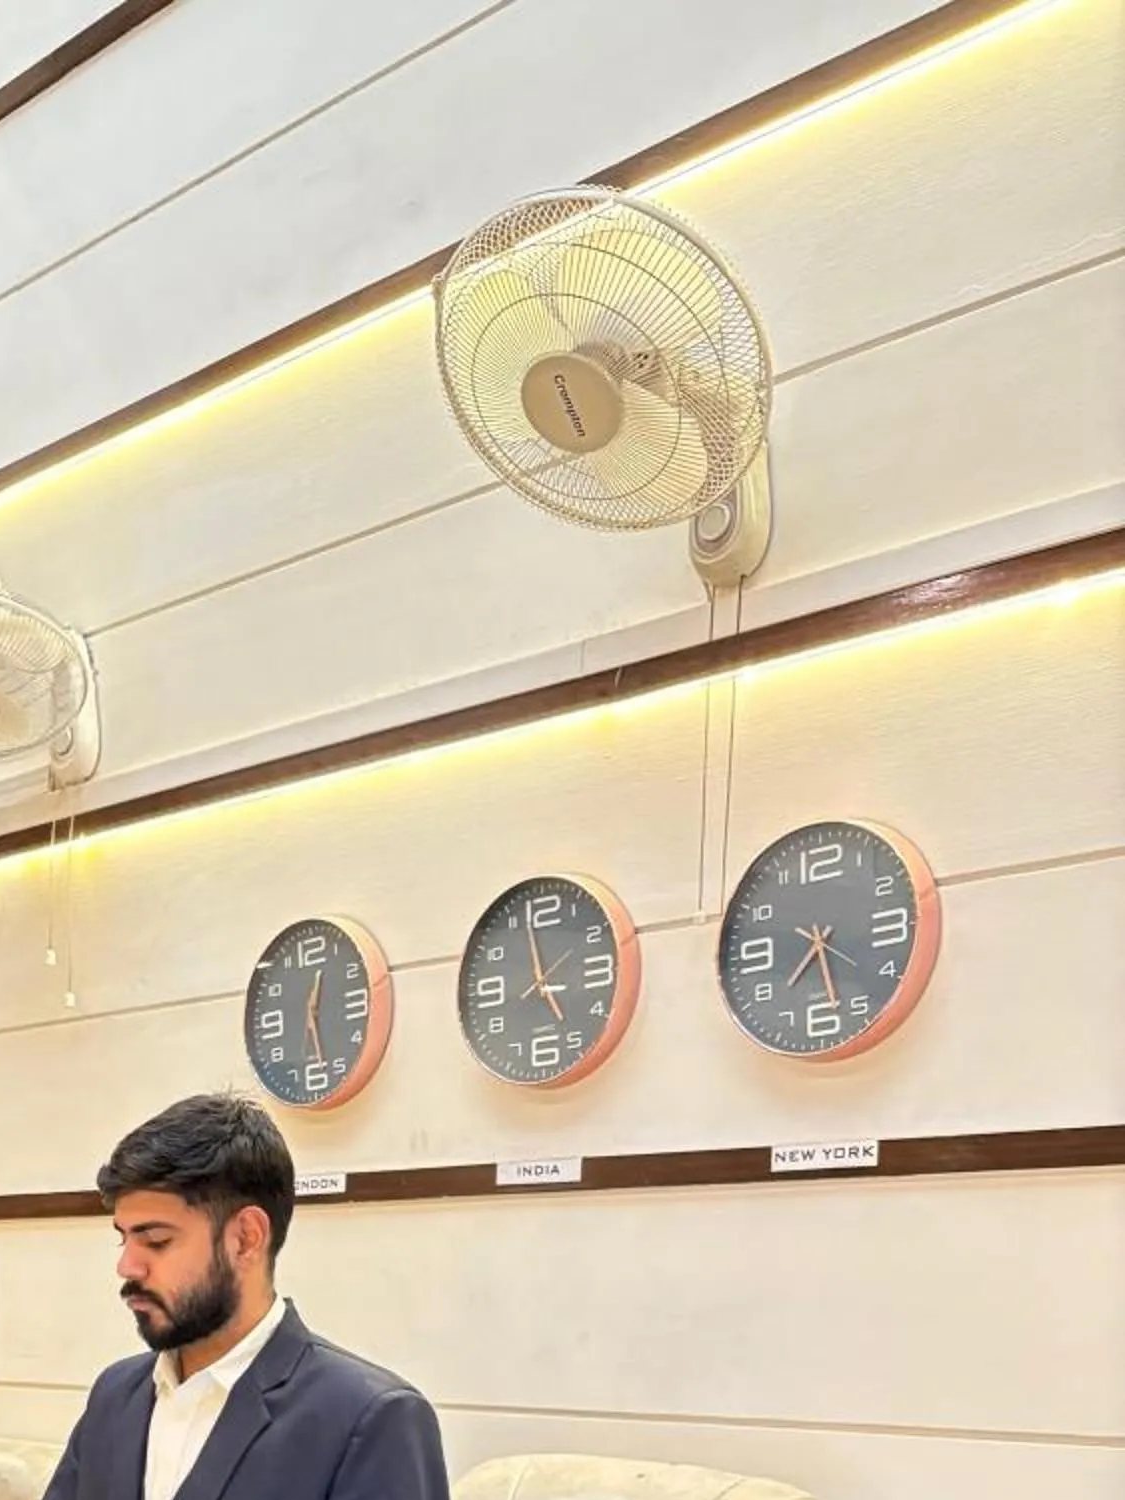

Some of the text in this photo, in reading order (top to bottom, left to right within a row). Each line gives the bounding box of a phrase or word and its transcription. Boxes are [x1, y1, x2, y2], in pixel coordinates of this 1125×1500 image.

[554, 373, 586, 437] Crompton
[800, 843, 843, 885] 12
[857, 852, 862, 867] 1
[778, 869, 789, 885] 11
[875, 875, 893, 896] 2
[526, 894, 562, 928] 12
[571, 903, 576, 917] 1
[752, 904, 772, 922] 10
[508, 916, 517, 929] 11
[871, 907, 908, 948] 3
[586, 925, 602, 943] 2
[298, 936, 327, 969] 12
[334, 943, 338, 956] 1
[740, 937, 773, 975] 9
[346, 963, 360, 979] 2
[584, 954, 613, 989] 3
[878, 959, 897, 978] 4
[477, 975, 505, 1009] 9
[755, 983, 772, 1001] 8
[344, 988, 368, 1020] 3
[589, 1000, 605, 1017] 4
[850, 995, 869, 1015] 5
[261, 1009, 284, 1040] 9
[489, 1016, 504, 1033] 8
[778, 1011, 794, 1027] 7
[806, 1000, 840, 1038] 6
[350, 1029, 363, 1044] 4
[567, 1031, 582, 1049] 5
[270, 1047, 284, 1062] 8
[508, 1042, 522, 1056] 7
[531, 1034, 560, 1067] 6
[287, 1069, 299, 1082] 7
[333, 1058, 346, 1075] 5
[305, 1062, 328, 1091] 6
[775, 1145, 875, 1163] NEW YORK
[516, 1164, 560, 1178] INDIA
[295, 1179, 339, 1192] ONDON
